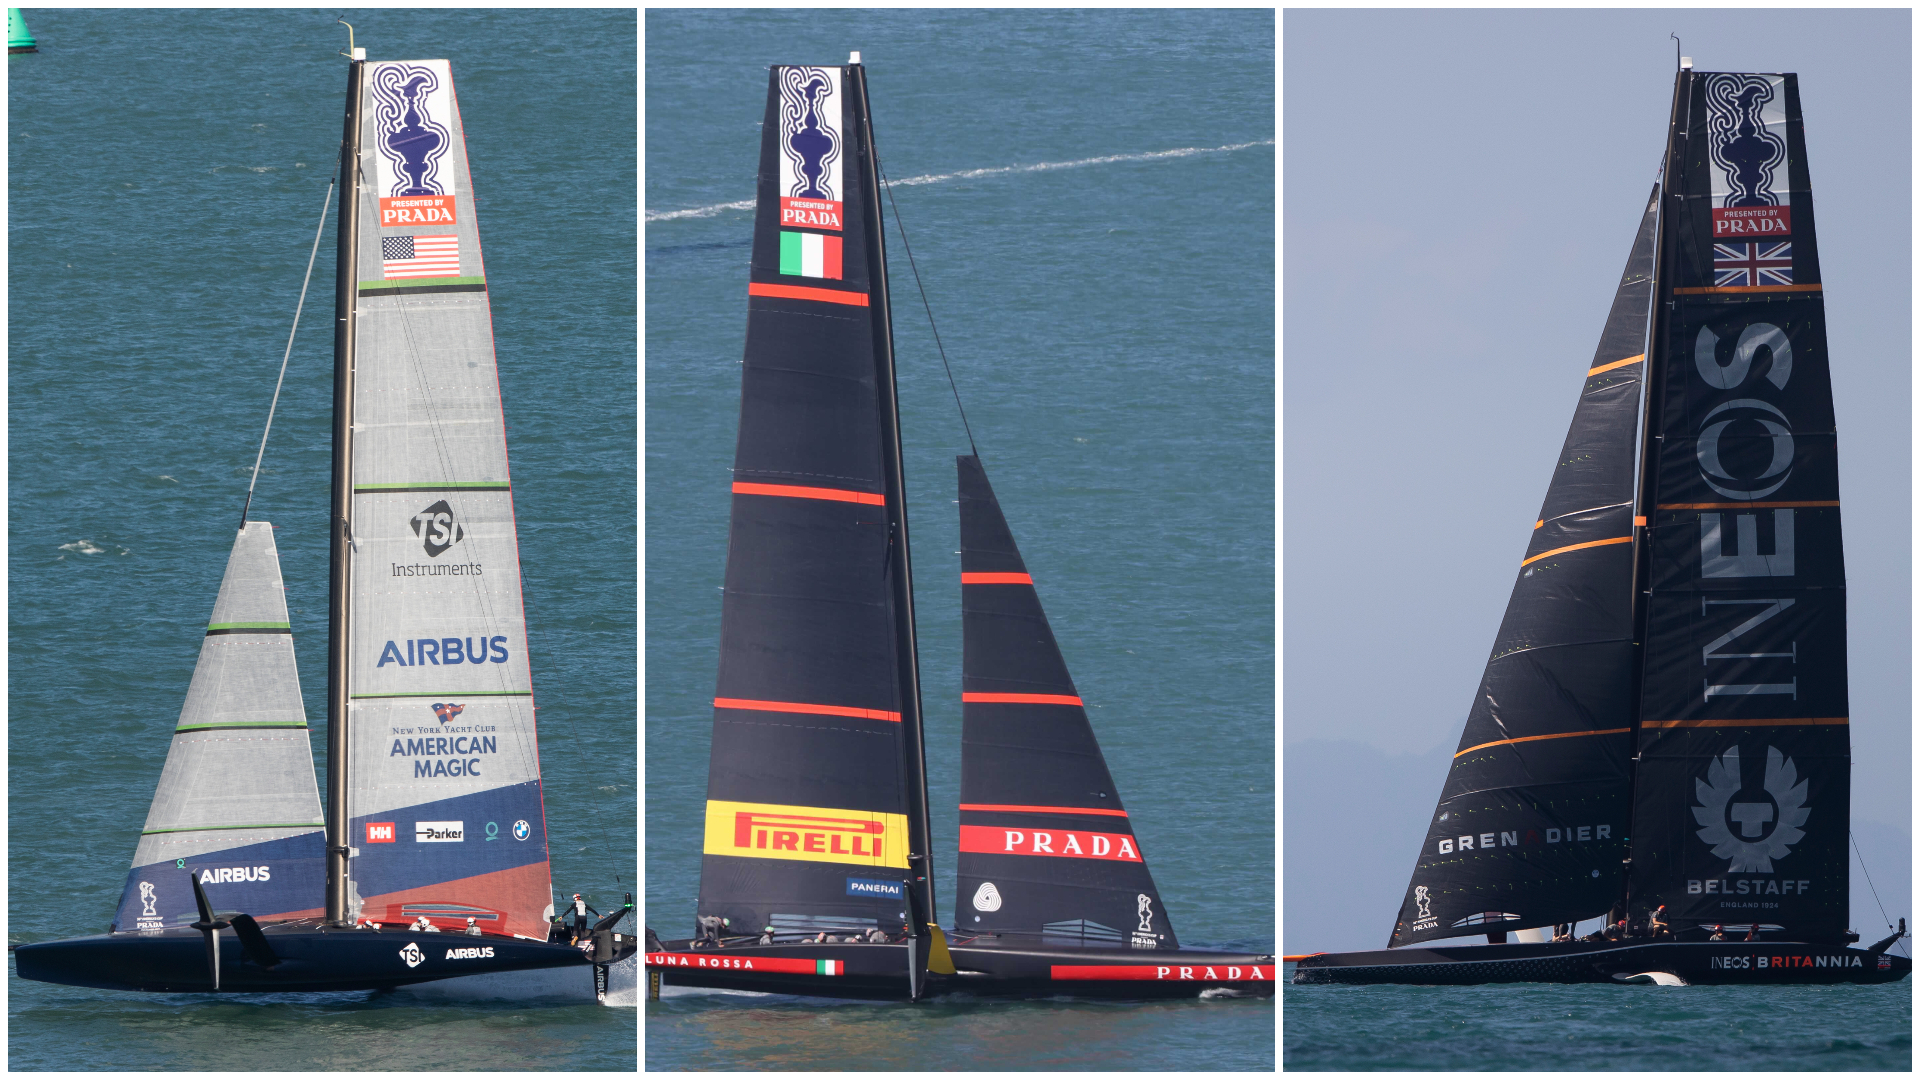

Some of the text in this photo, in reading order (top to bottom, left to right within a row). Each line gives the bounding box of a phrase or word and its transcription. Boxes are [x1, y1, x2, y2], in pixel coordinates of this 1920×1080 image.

[391, 198, 444, 208] PRESENTED BY
[790, 200, 834, 211] PRESENTED BY
[383, 208, 453, 222] PRADA
[783, 209, 840, 226] PRADA
[1724, 209, 1778, 218] PRESENTED BY
[1716, 219, 1787, 233] PRADA
[1694, 322, 1797, 703] INEOS
[414, 511, 462, 548] TSI
[391, 562, 483, 577] Instruments
[377, 635, 509, 667] AIRBUS
[389, 735, 497, 757] AMERICAN
[414, 758, 481, 778] MAGIC
[369, 826, 392, 840] HH
[425, 827, 462, 839] Parker
[734, 812, 884, 857] PIRELLI
[1438, 825, 1611, 854] GRENADIER
[1004, 830, 1138, 859] PRADA
[200, 866, 271, 884] AIRBUS
[851, 882, 900, 894] PANERAI
[1687, 879, 1810, 895] BELSTAFF
[1413, 921, 1438, 932] PRADA
[1131, 936, 1157, 946] PRADA
[445, 946, 495, 960] AIRBUS
[645, 955, 753, 969] LUNA ROSSA
[1711, 955, 1863, 969] INEOS BRITANNIA
[1157, 966, 1265, 980] PRADA
[596, 965, 606, 1002] AIRBUS
